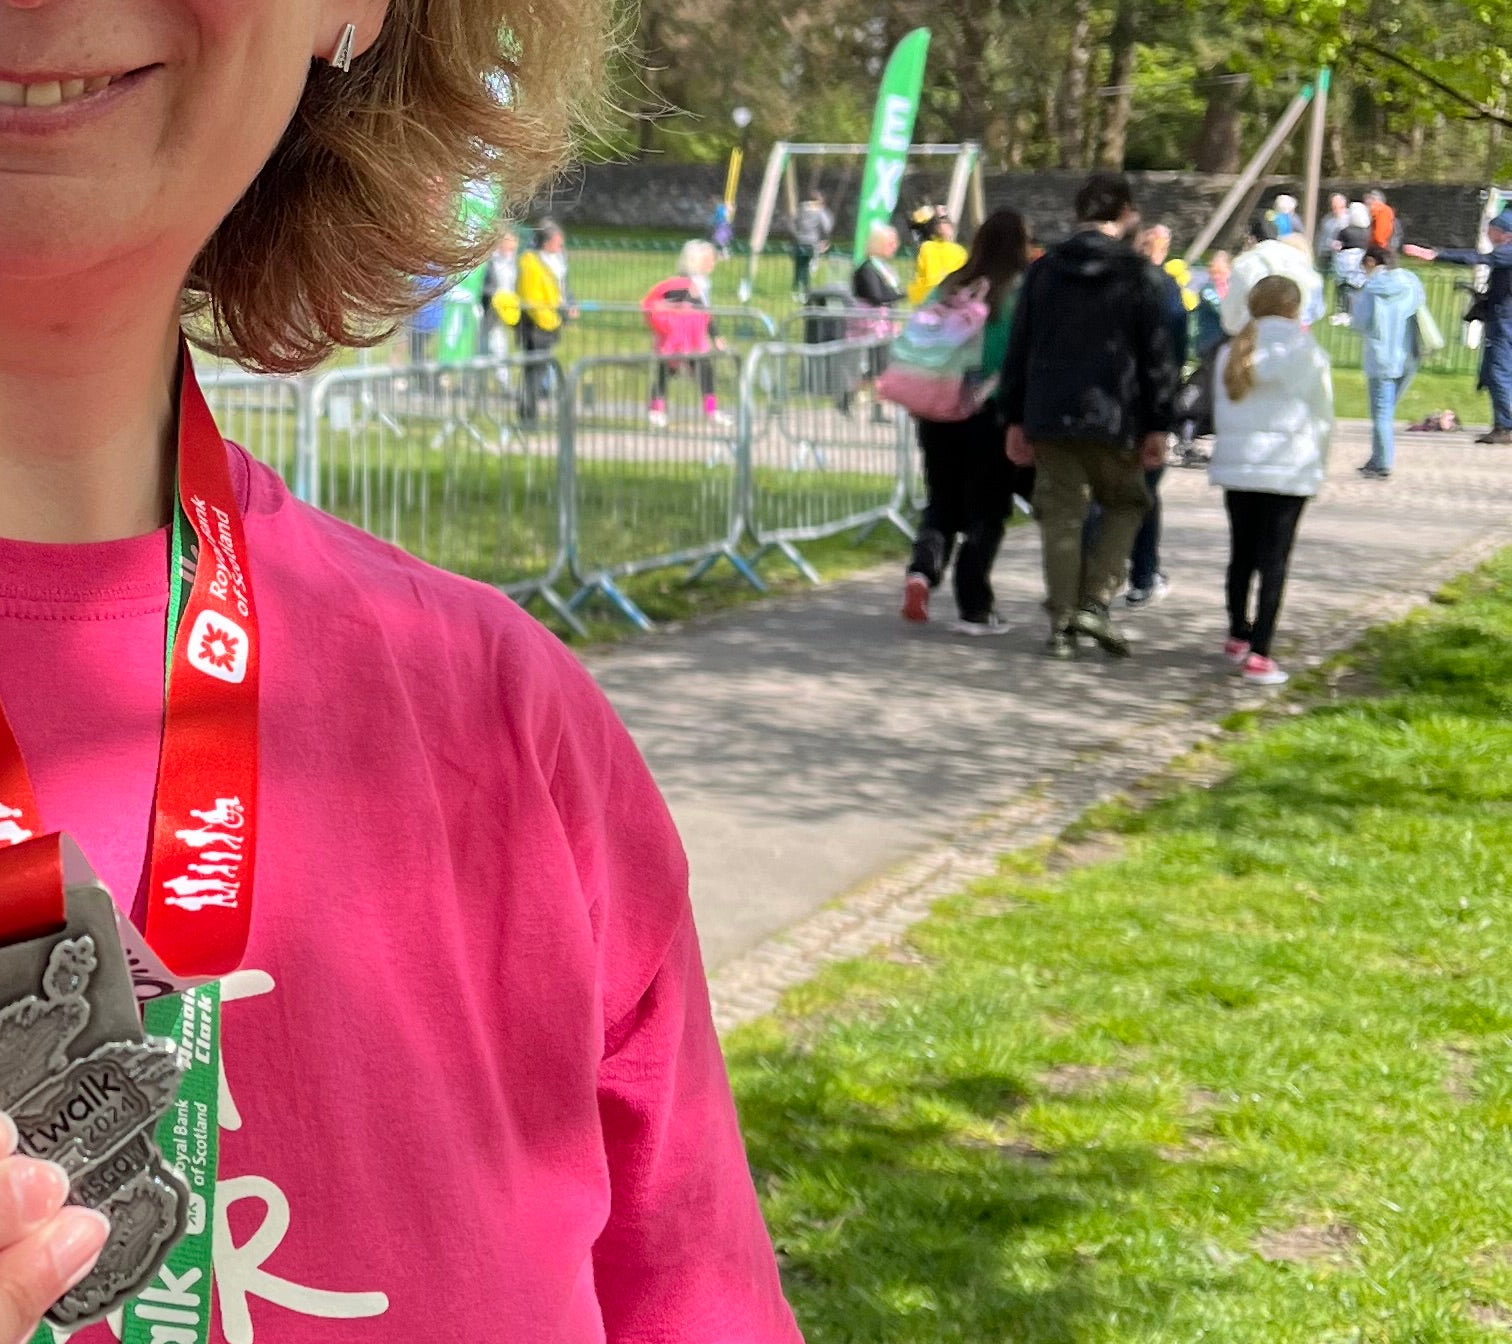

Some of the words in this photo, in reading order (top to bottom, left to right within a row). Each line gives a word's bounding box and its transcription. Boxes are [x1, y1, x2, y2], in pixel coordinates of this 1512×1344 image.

[195, 993, 212, 1065] Clark
[17, 1072, 121, 1154] twalk
[173, 1098, 189, 1136] Bank
[193, 1101, 208, 1166] Scotland
[171, 1137, 190, 1173] oyal
[190, 1165, 206, 1187] of
